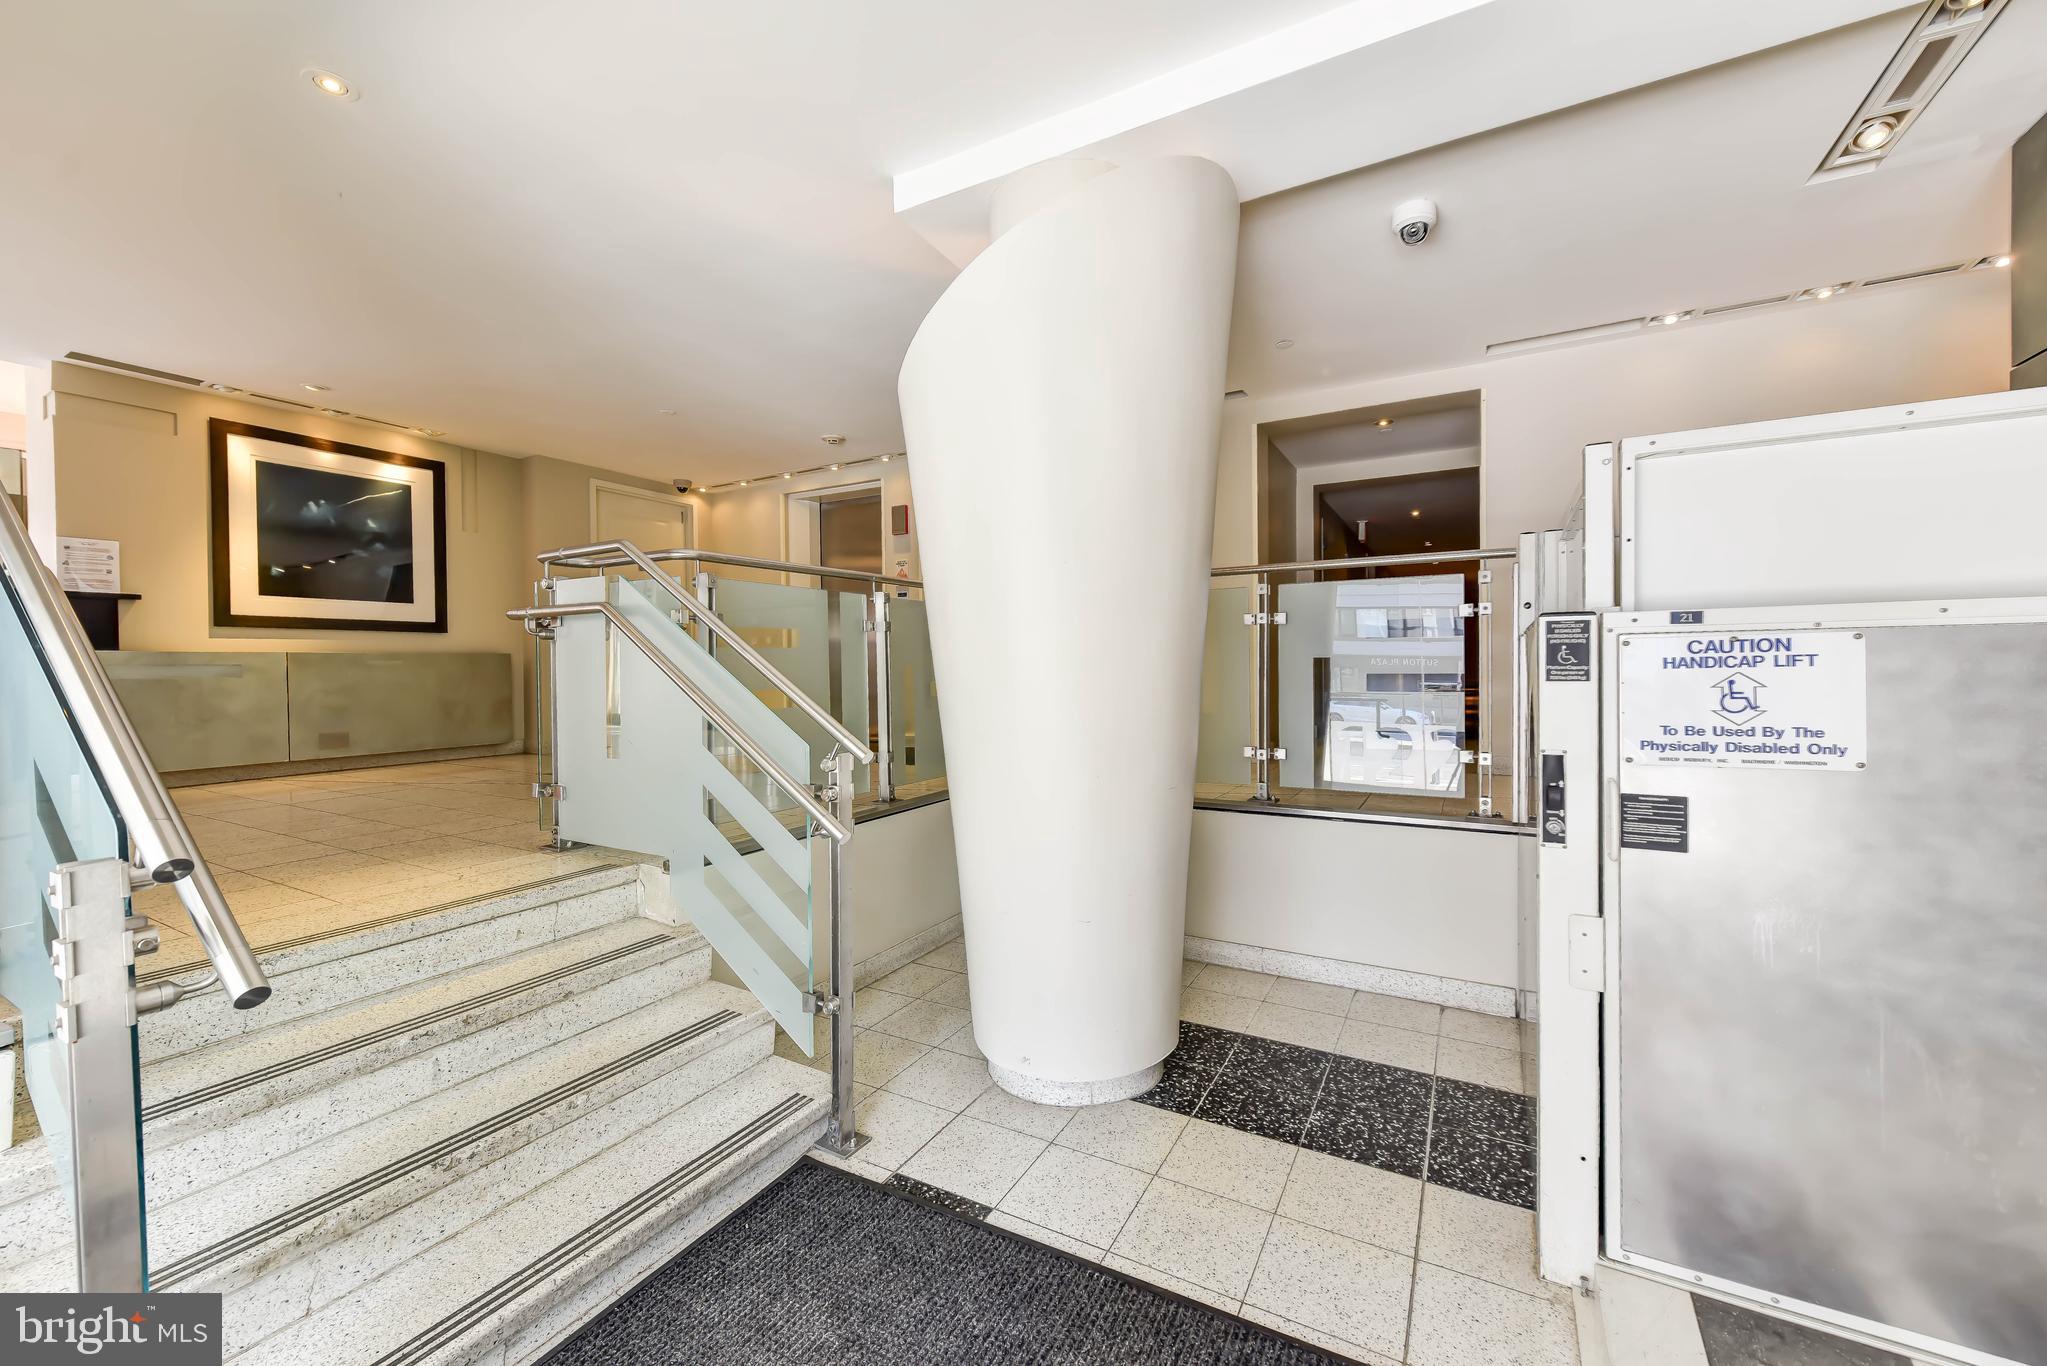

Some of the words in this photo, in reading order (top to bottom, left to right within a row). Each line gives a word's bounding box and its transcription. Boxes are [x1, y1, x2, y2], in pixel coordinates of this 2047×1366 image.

[1680, 613, 1693, 623] 21
[1687, 638, 1792, 655] CAUTION
[1662, 655, 1766, 669] HANDICAP
[1774, 654, 1819, 668] LIFT
[1659, 725, 1679, 737] To
[1685, 725, 1706, 737] Be
[1712, 726, 1756, 738] Used
[1762, 726, 1785, 740] By
[1792, 726, 1826, 739] The
[1640, 740, 1719, 755] Physically
[1725, 741, 1800, 755] Disabled
[1807, 743, 1849, 758] Only
